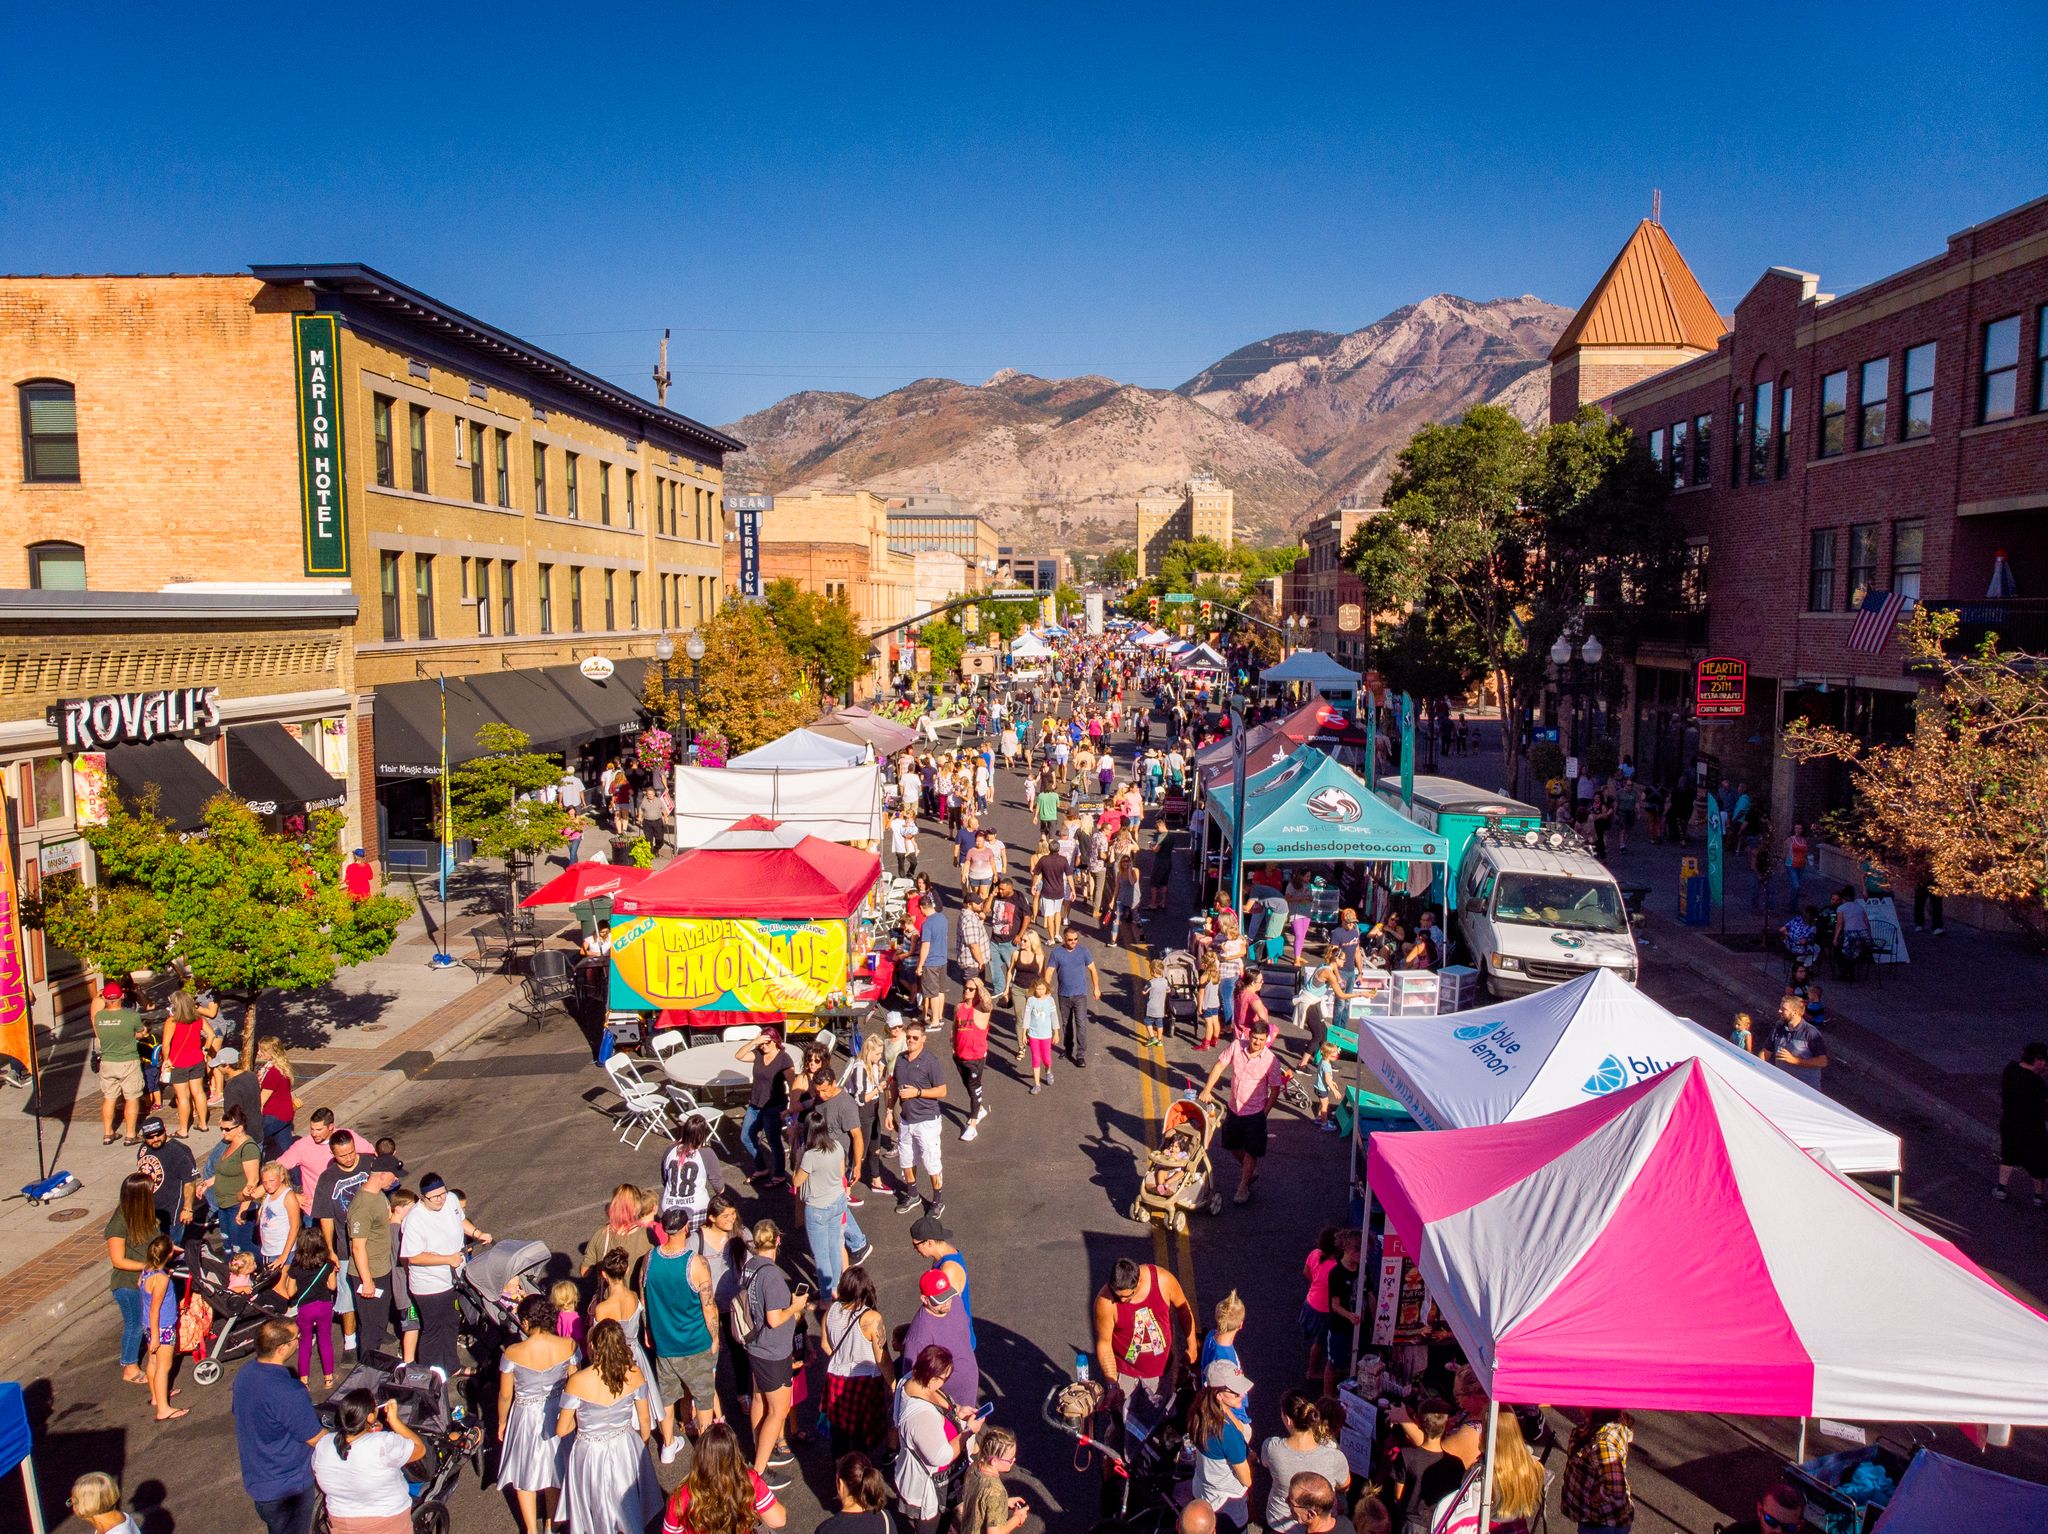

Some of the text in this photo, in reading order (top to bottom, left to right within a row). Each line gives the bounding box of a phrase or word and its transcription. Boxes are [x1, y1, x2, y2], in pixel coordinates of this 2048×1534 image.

[310, 349, 333, 538] MARION HOTEL
[729, 497, 766, 509] SEAN
[743, 513, 755, 593] HERRICK
[1701, 662, 1742, 675] HEARTH
[1711, 681, 1732, 692] 25TH
[64, 686, 221, 750] ROVALI'S
[379, 763, 398, 773] Hair
[399, 764, 422, 775] Magic
[86, 760, 97, 816] SALADS
[1276, 840, 1412, 854] andshesdopetoo.com
[662, 919, 743, 953] LAVENDER
[769, 924, 781, 932] ALL
[613, 935, 630, 952] ICE
[642, 933, 831, 1000] LEMONADE
[1490, 1026, 1521, 1055] blue
[1468, 1038, 1509, 1077] lemon
[1381, 1059, 1397, 1084] LIVE
[668, 1159, 700, 1198] 18
[665, 1196, 695, 1206] THE WOLVES
[1124, 1306, 1167, 1365] A
[1341, 1437, 1369, 1457] CASH
